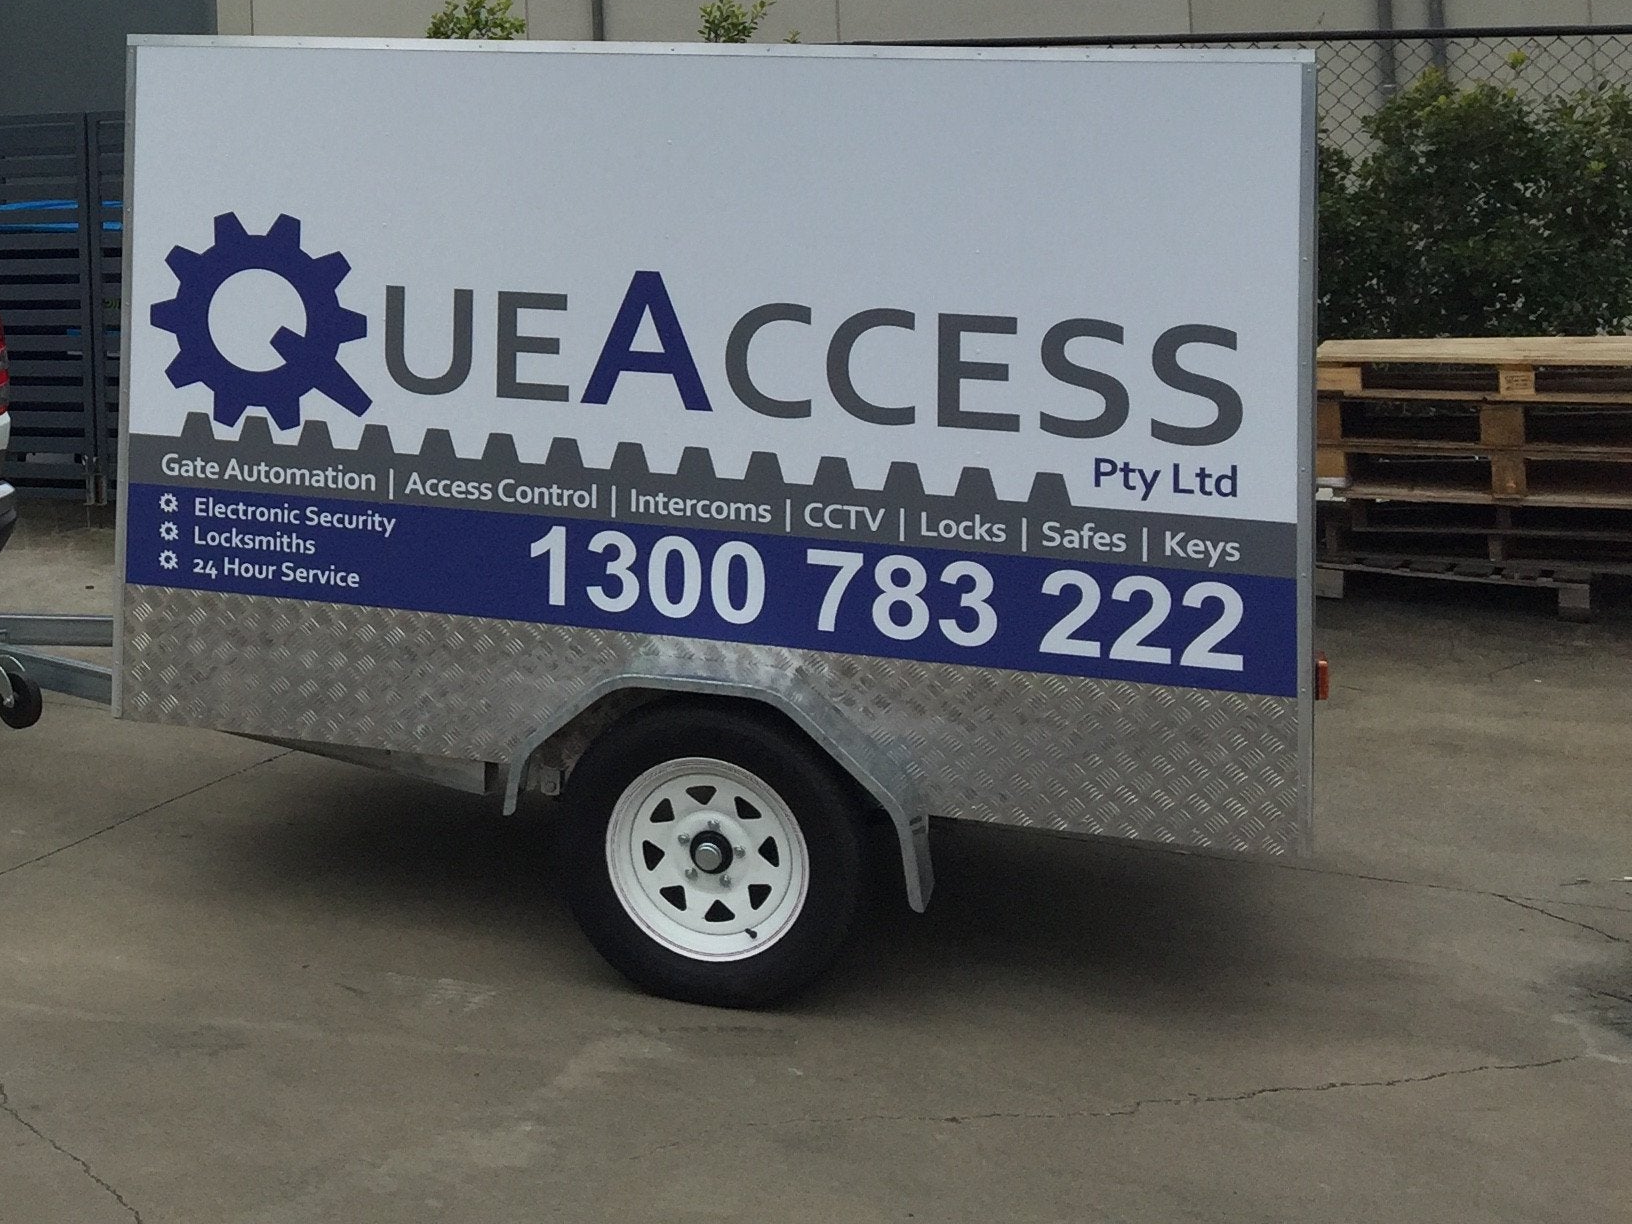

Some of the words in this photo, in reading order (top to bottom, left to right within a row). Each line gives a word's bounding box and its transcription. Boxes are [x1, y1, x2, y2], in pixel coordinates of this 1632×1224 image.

[1093, 457, 1160, 501] Pty
[1172, 463, 1239, 498] Ltd
[161, 453, 220, 480] Gate
[222, 457, 377, 492] Automation
[404, 471, 492, 501] Access
[497, 478, 598, 509] Control
[630, 488, 773, 524] Intercoms
[804, 501, 886, 532] CCTV
[920, 511, 1007, 543] Locks
[1041, 521, 1128, 554] Safes
[1164, 531, 1242, 568] Keys
[194, 497, 300, 525] Electronic
[305, 506, 397, 538] Security
[194, 525, 316, 555] Locksmiths
[192, 558, 218, 579] 24
[223, 557, 277, 580] Hour
[281, 562, 361, 588] Service
[530, 525, 766, 625] 1300
[806, 548, 999, 648] 783
[1039, 569, 1245, 672] 222
